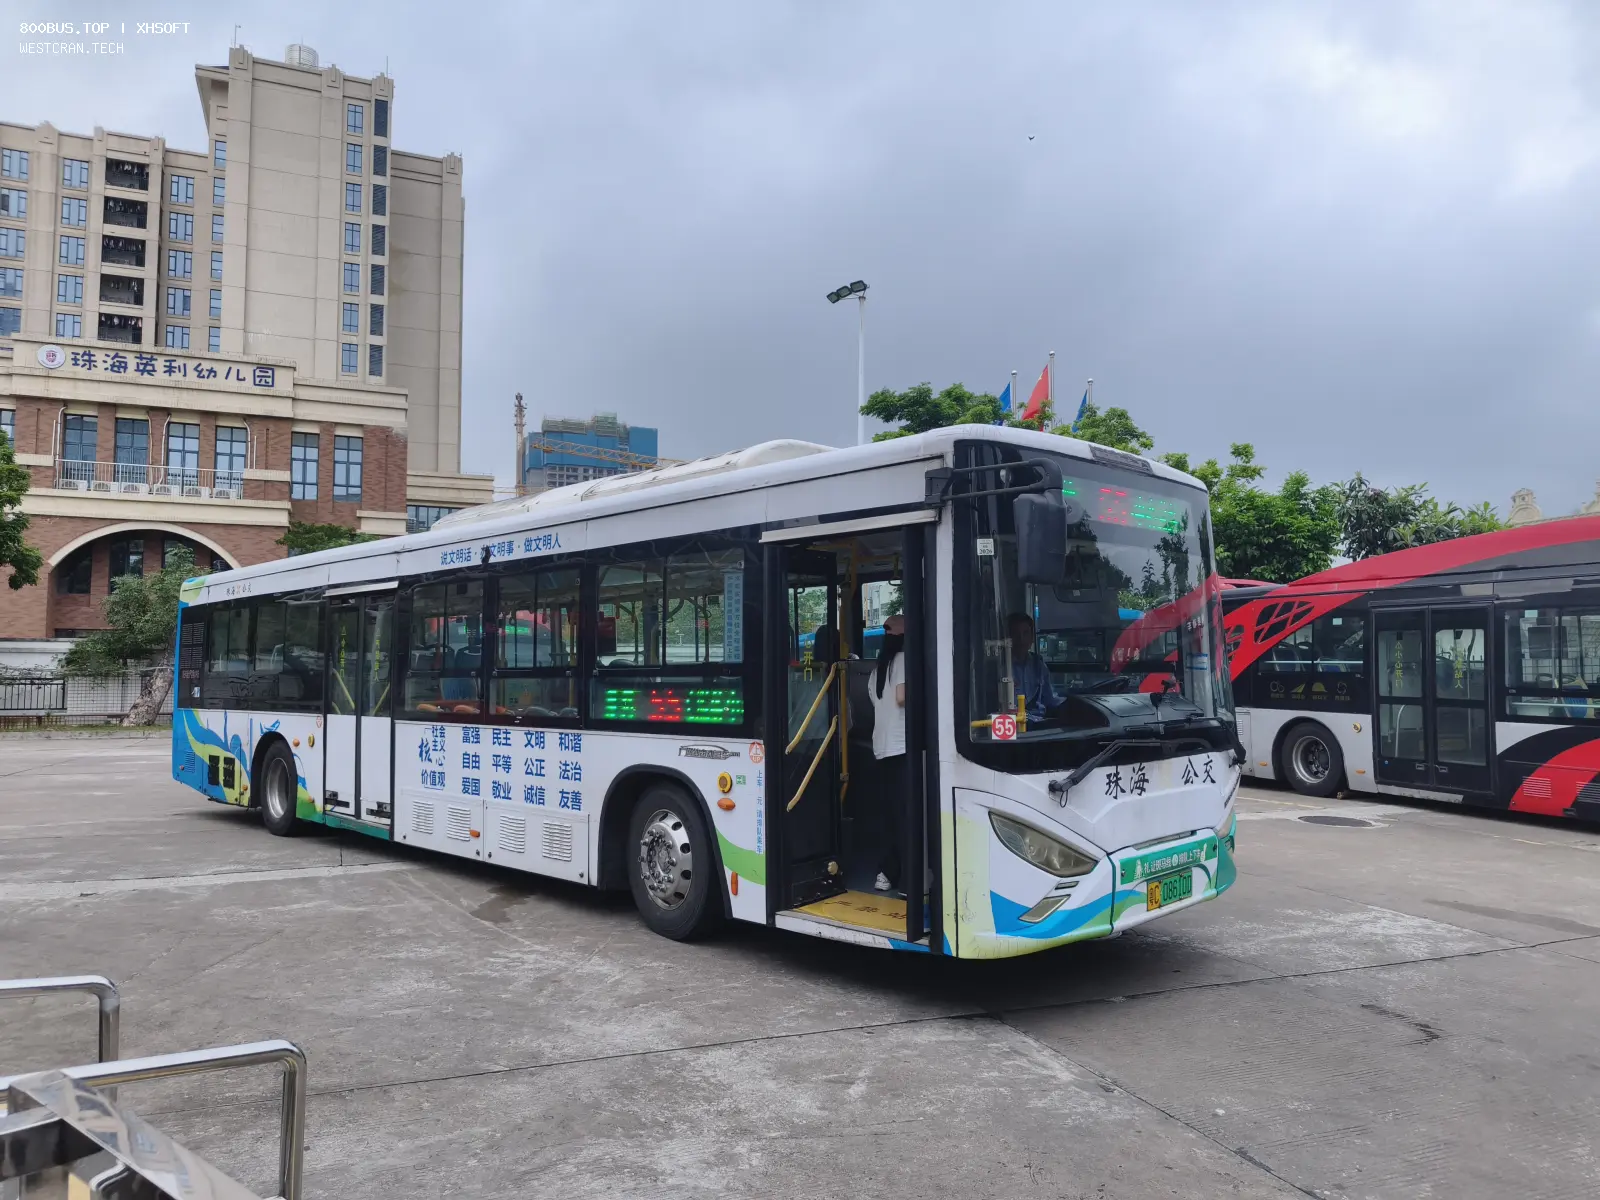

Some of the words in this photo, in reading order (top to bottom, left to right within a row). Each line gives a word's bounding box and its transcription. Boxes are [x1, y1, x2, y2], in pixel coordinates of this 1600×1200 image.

[71, 350, 275, 388] 珠海英利幼儿园
[461, 726, 481, 745] 富强
[491, 728, 512, 747] 民主
[523, 730, 546, 750] 文明
[558, 732, 582, 753] 和谐
[994, 718, 1014, 736] 55
[461, 752, 481, 771] 自由
[491, 754, 512, 774] 平等
[523, 757, 546, 778] 公正
[558, 760, 582, 782] 法治
[1105, 764, 1150, 800] 珠海
[1181, 754, 1217, 786] 公交
[461, 777, 481, 797] 爱国
[491, 780, 512, 801] 敬业
[523, 784, 546, 806] 诚信
[558, 788, 582, 811] 友善
